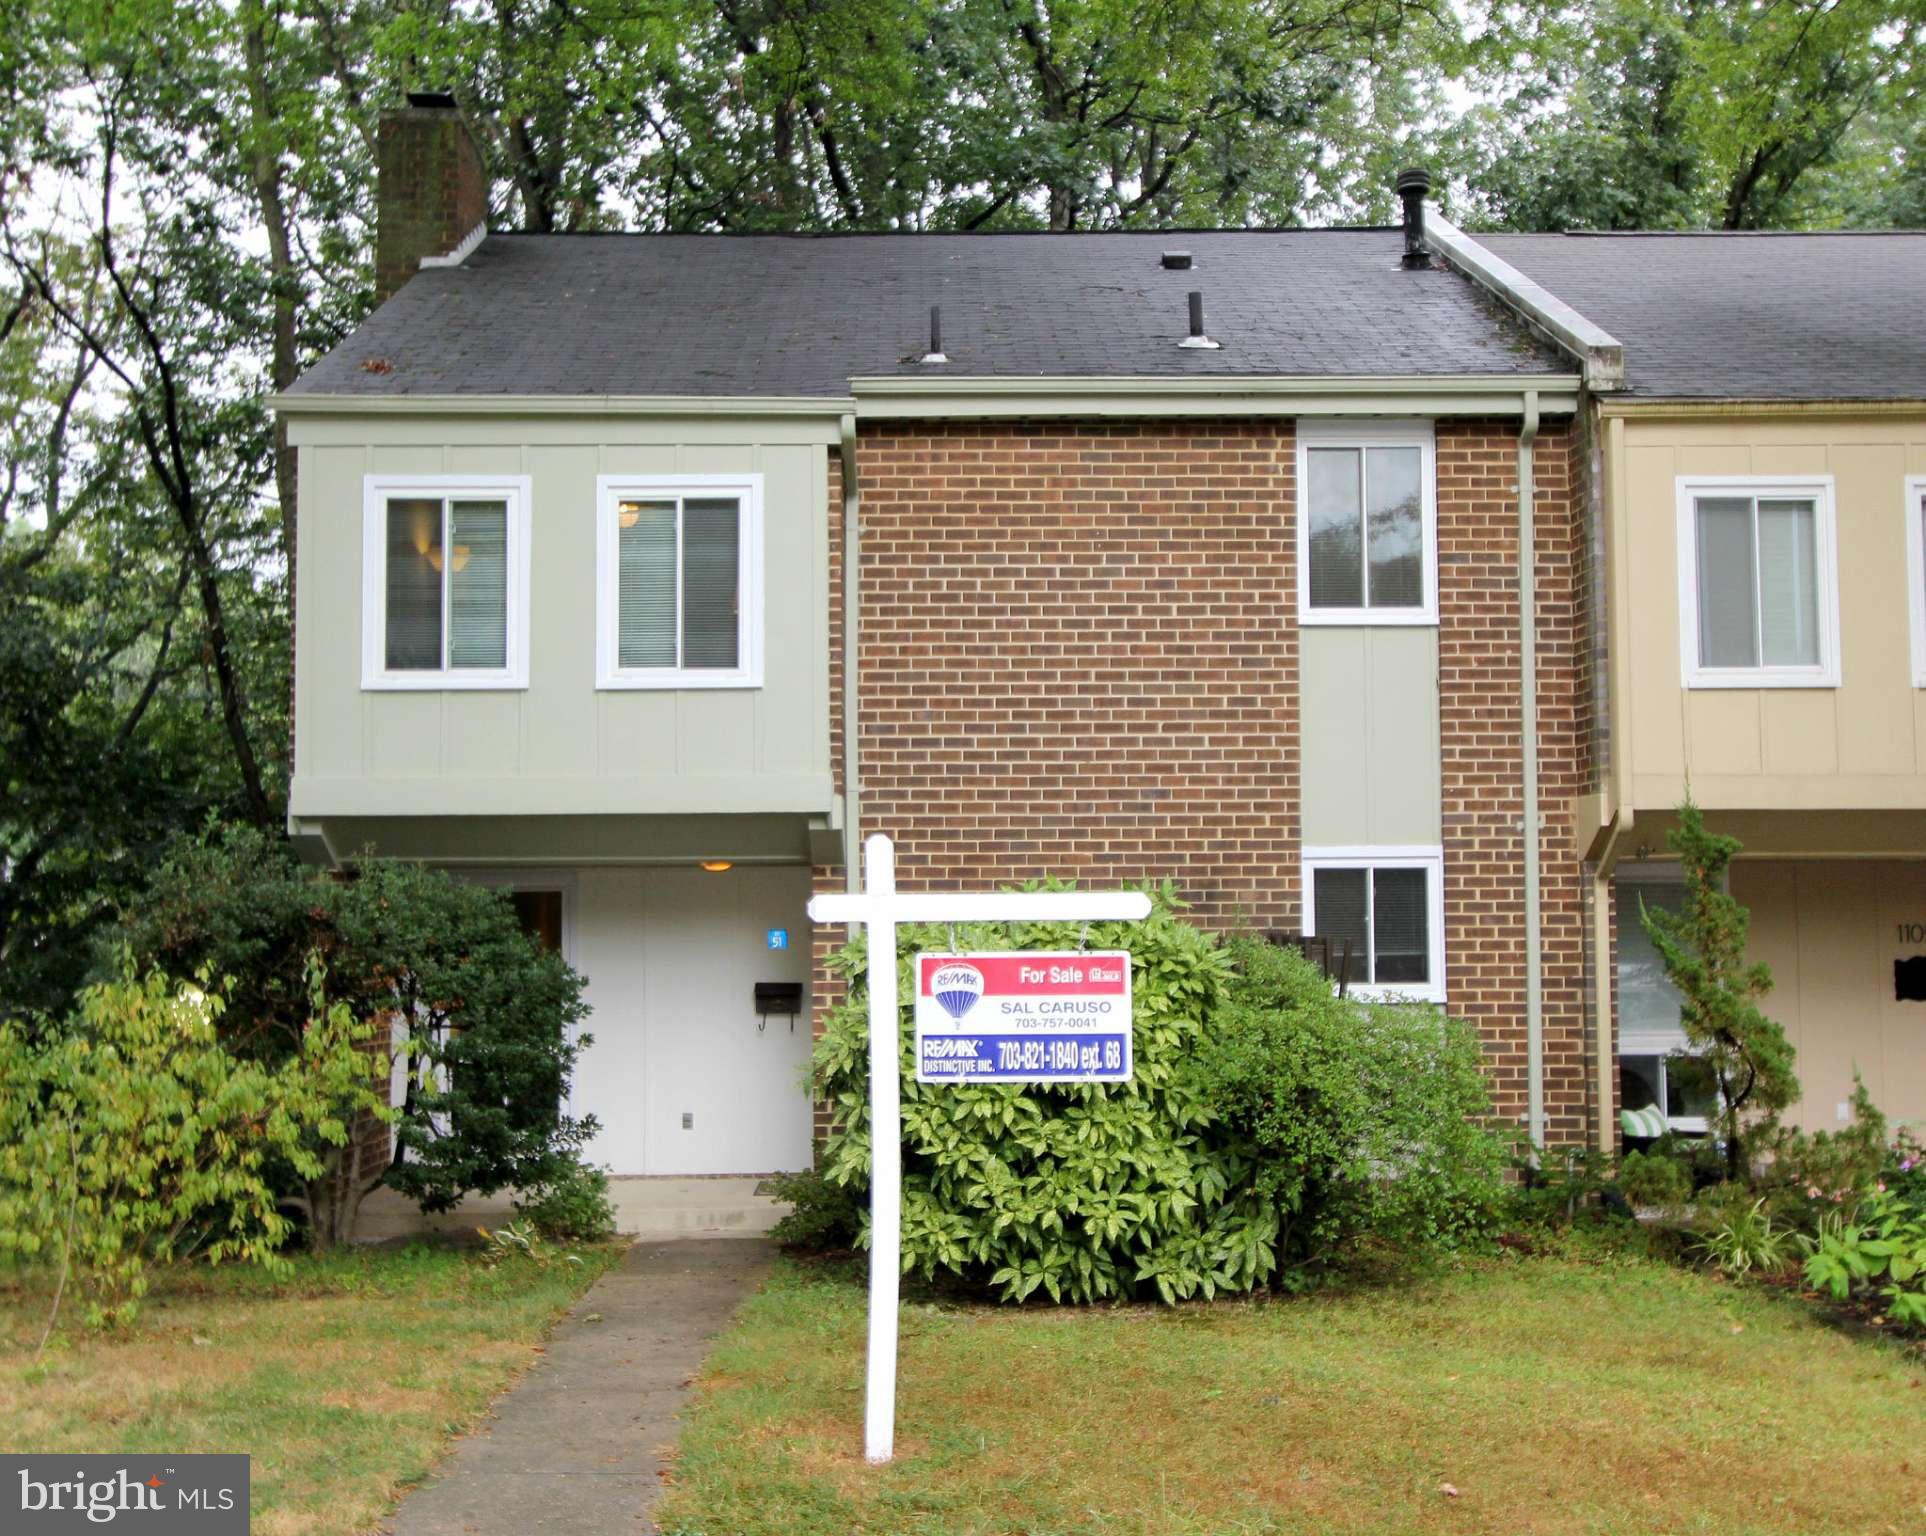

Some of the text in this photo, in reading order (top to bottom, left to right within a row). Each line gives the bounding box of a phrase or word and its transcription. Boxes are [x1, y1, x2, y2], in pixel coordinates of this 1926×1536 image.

[1898, 923, 1926, 944] 110
[1020, 966, 1046, 984] For
[1049, 966, 1083, 983] Sale
[1001, 1001, 1112, 1014] SAL CARUSO
[1015, 1018, 1097, 1028] 703-757-0041
[998, 1040, 1121, 1070] 703-821-1840 ext. 68
[924, 1059, 996, 1073] DISTINCTIVE INC.
